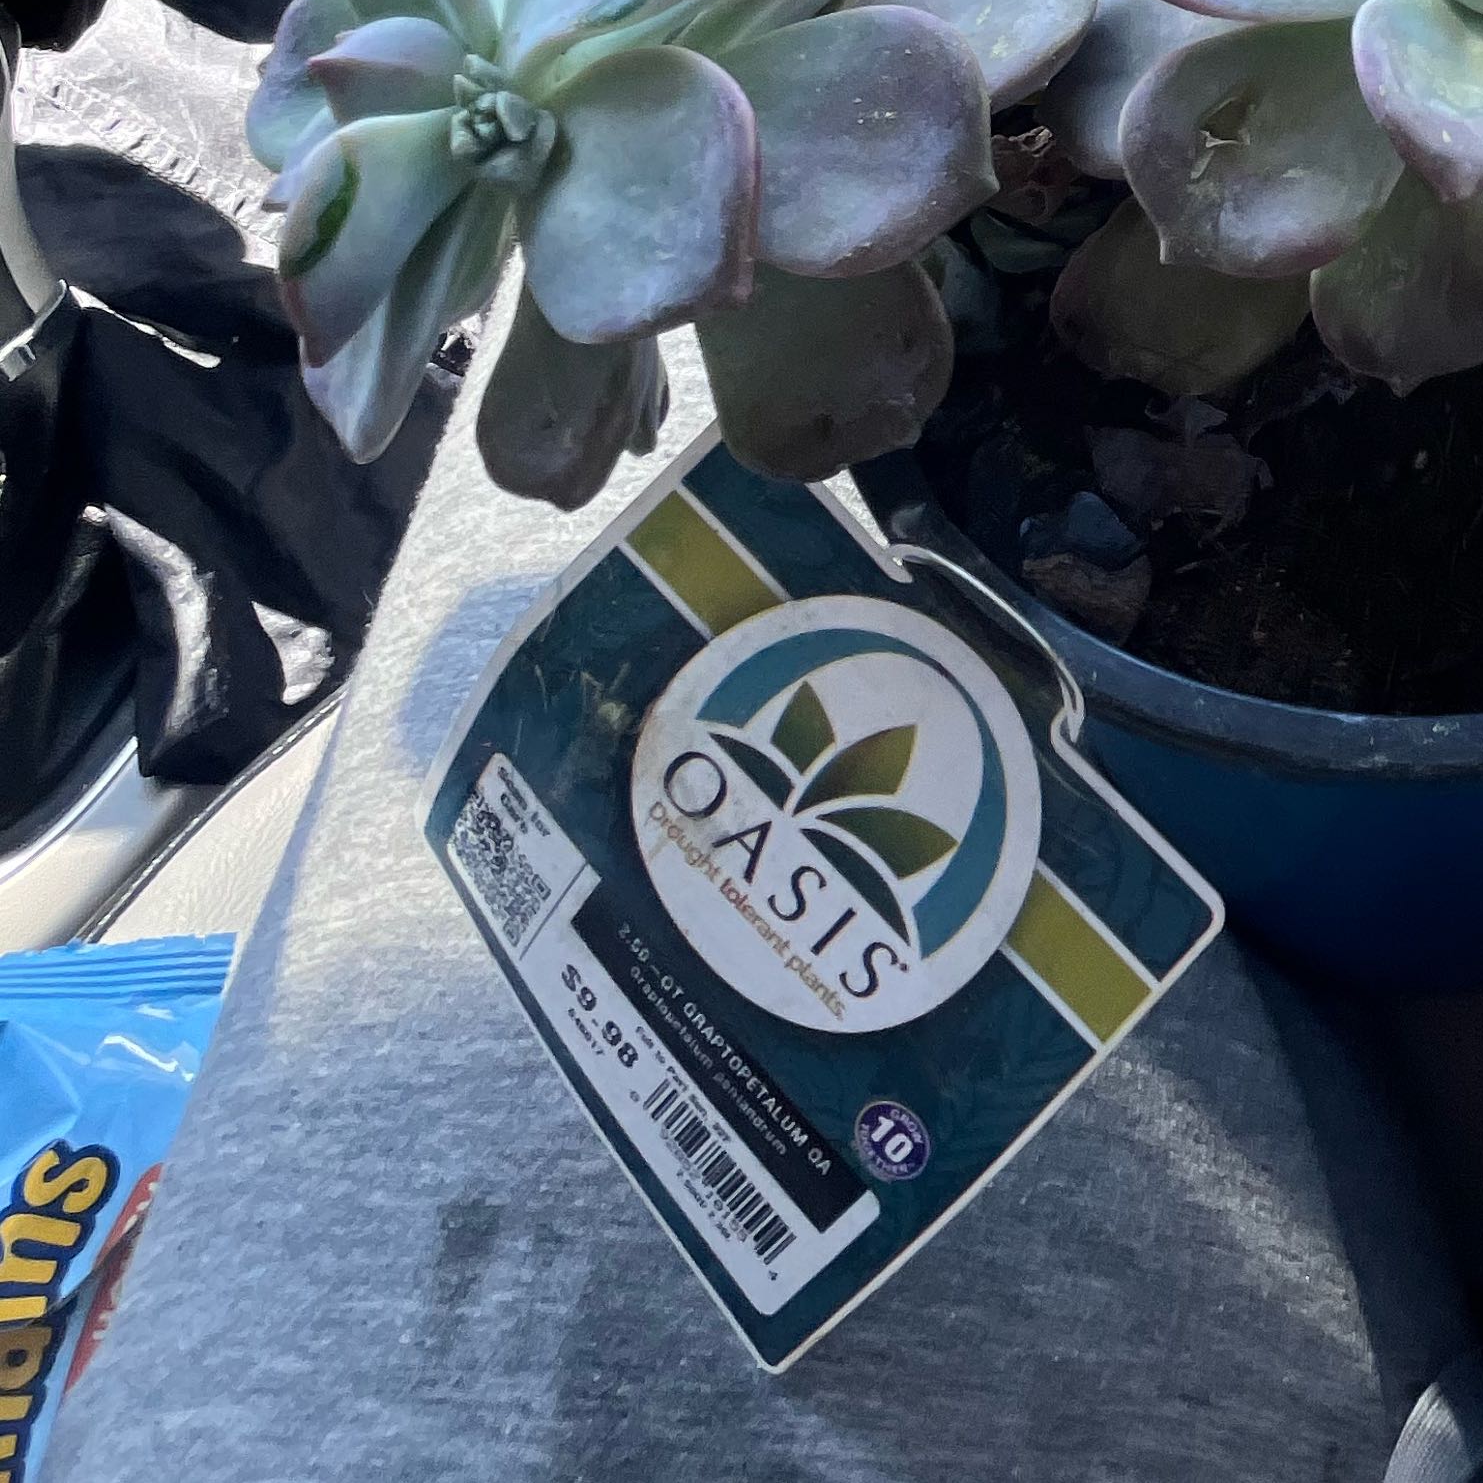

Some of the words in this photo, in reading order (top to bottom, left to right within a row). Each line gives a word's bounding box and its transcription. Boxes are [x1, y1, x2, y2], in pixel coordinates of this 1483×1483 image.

[646, 801, 725, 884] Drought
[717, 876, 793, 956] tolerant
[664, 750, 903, 1000] OASIS
[556, 962, 643, 1070] $9.98
[680, 999, 809, 1146] GRAPTOPETALUM
[870, 1116, 913, 1162] 10
